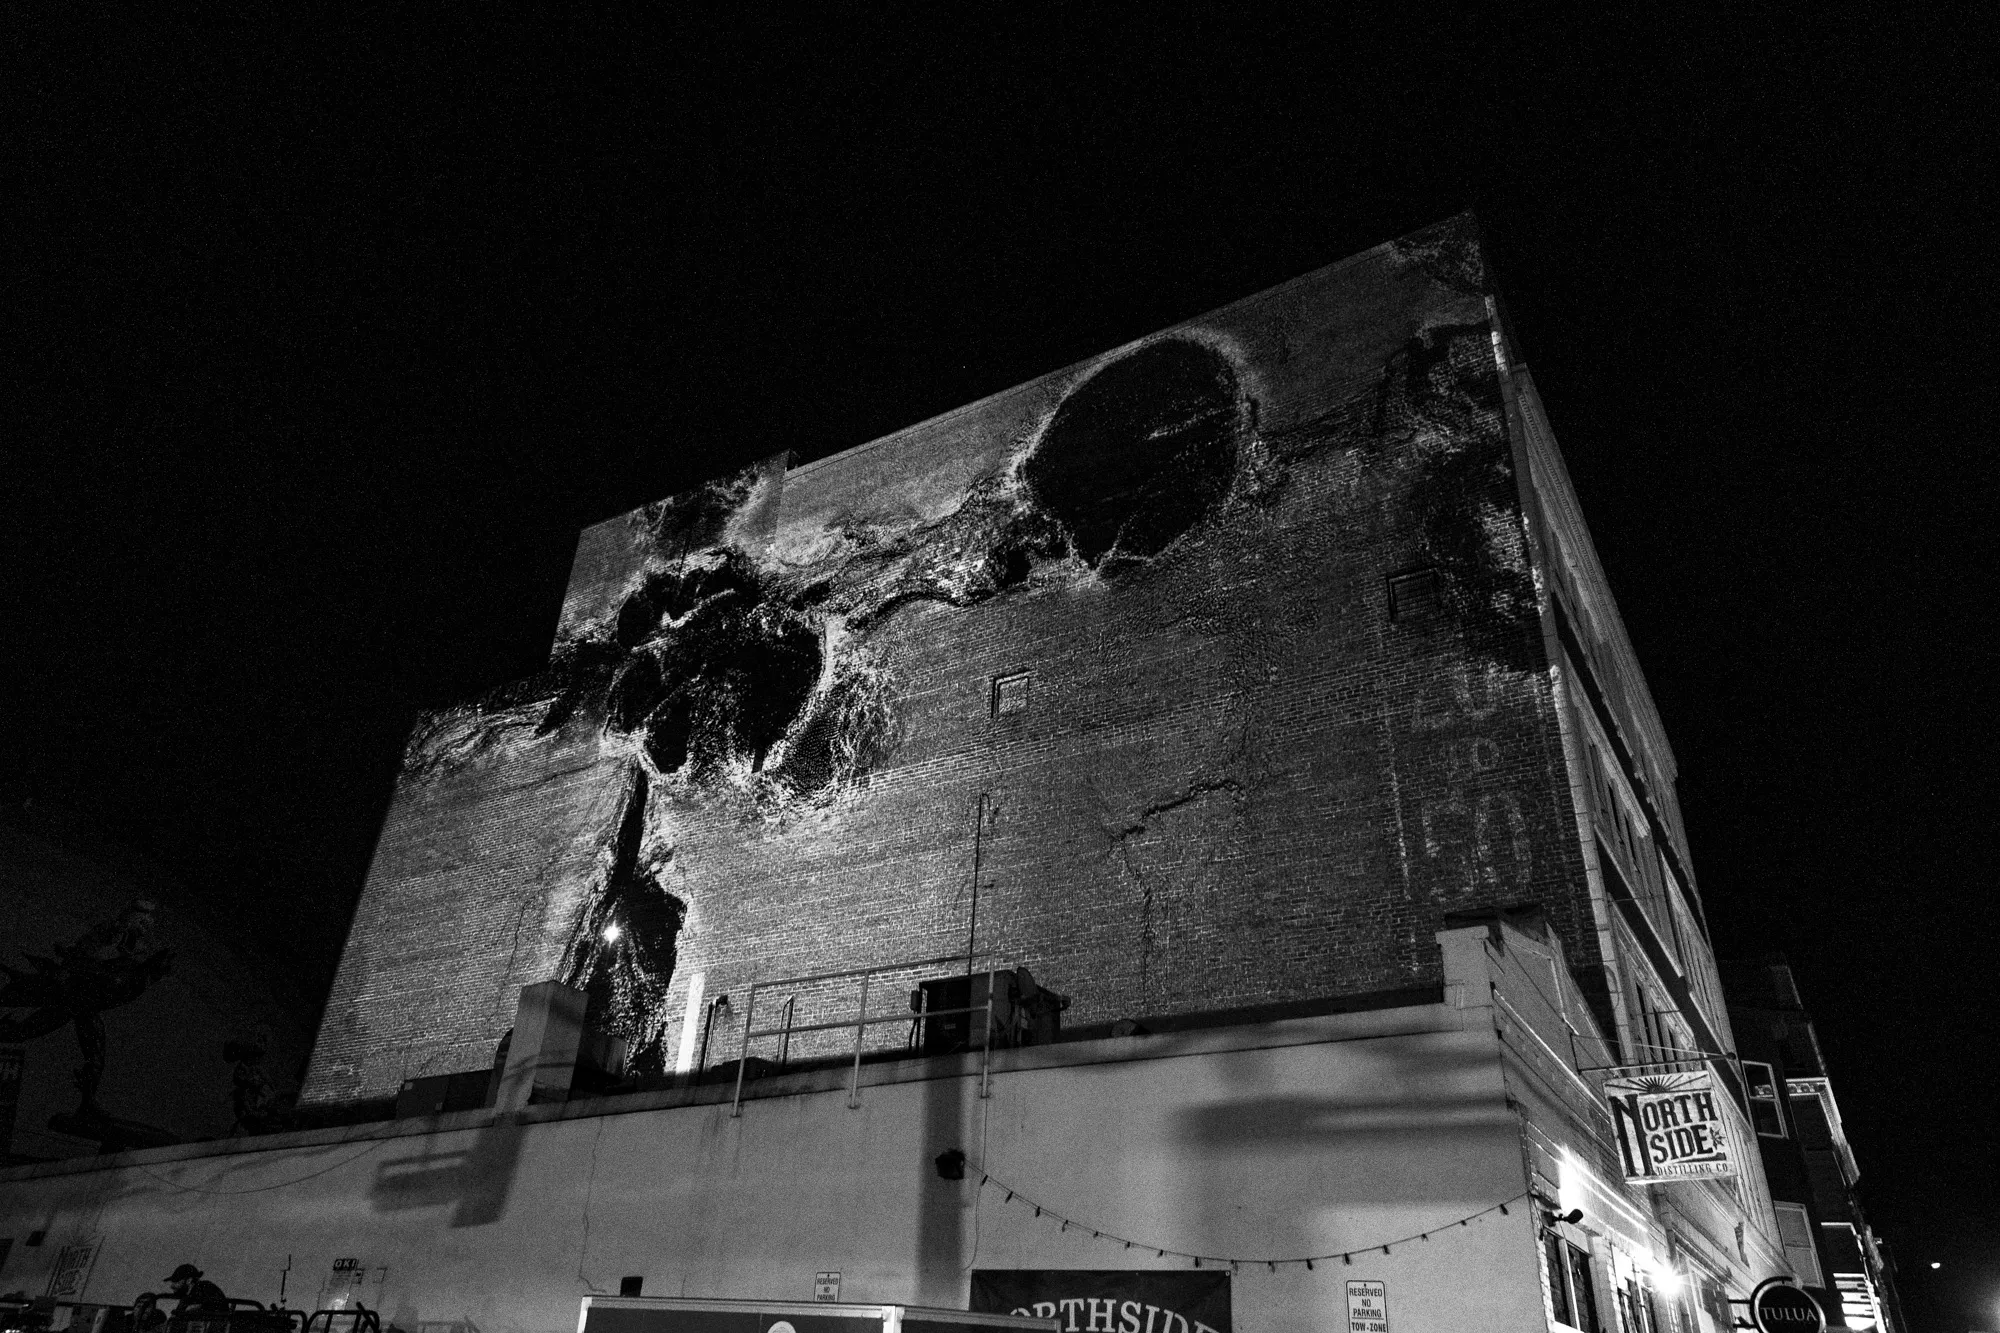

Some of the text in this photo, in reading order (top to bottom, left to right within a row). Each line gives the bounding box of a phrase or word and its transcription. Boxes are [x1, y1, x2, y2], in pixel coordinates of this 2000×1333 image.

[1608, 1092, 1718, 1177] NORTH
[1650, 1124, 1713, 1164] SIDE
[1656, 1164, 1712, 1177] DISTILLING
[1349, 1287, 1383, 1297] RESERVED
[1361, 1299, 1371, 1307] NO
[1353, 1308, 1382, 1317] PARKING
[1760, 1306, 1818, 1322] TULUA
